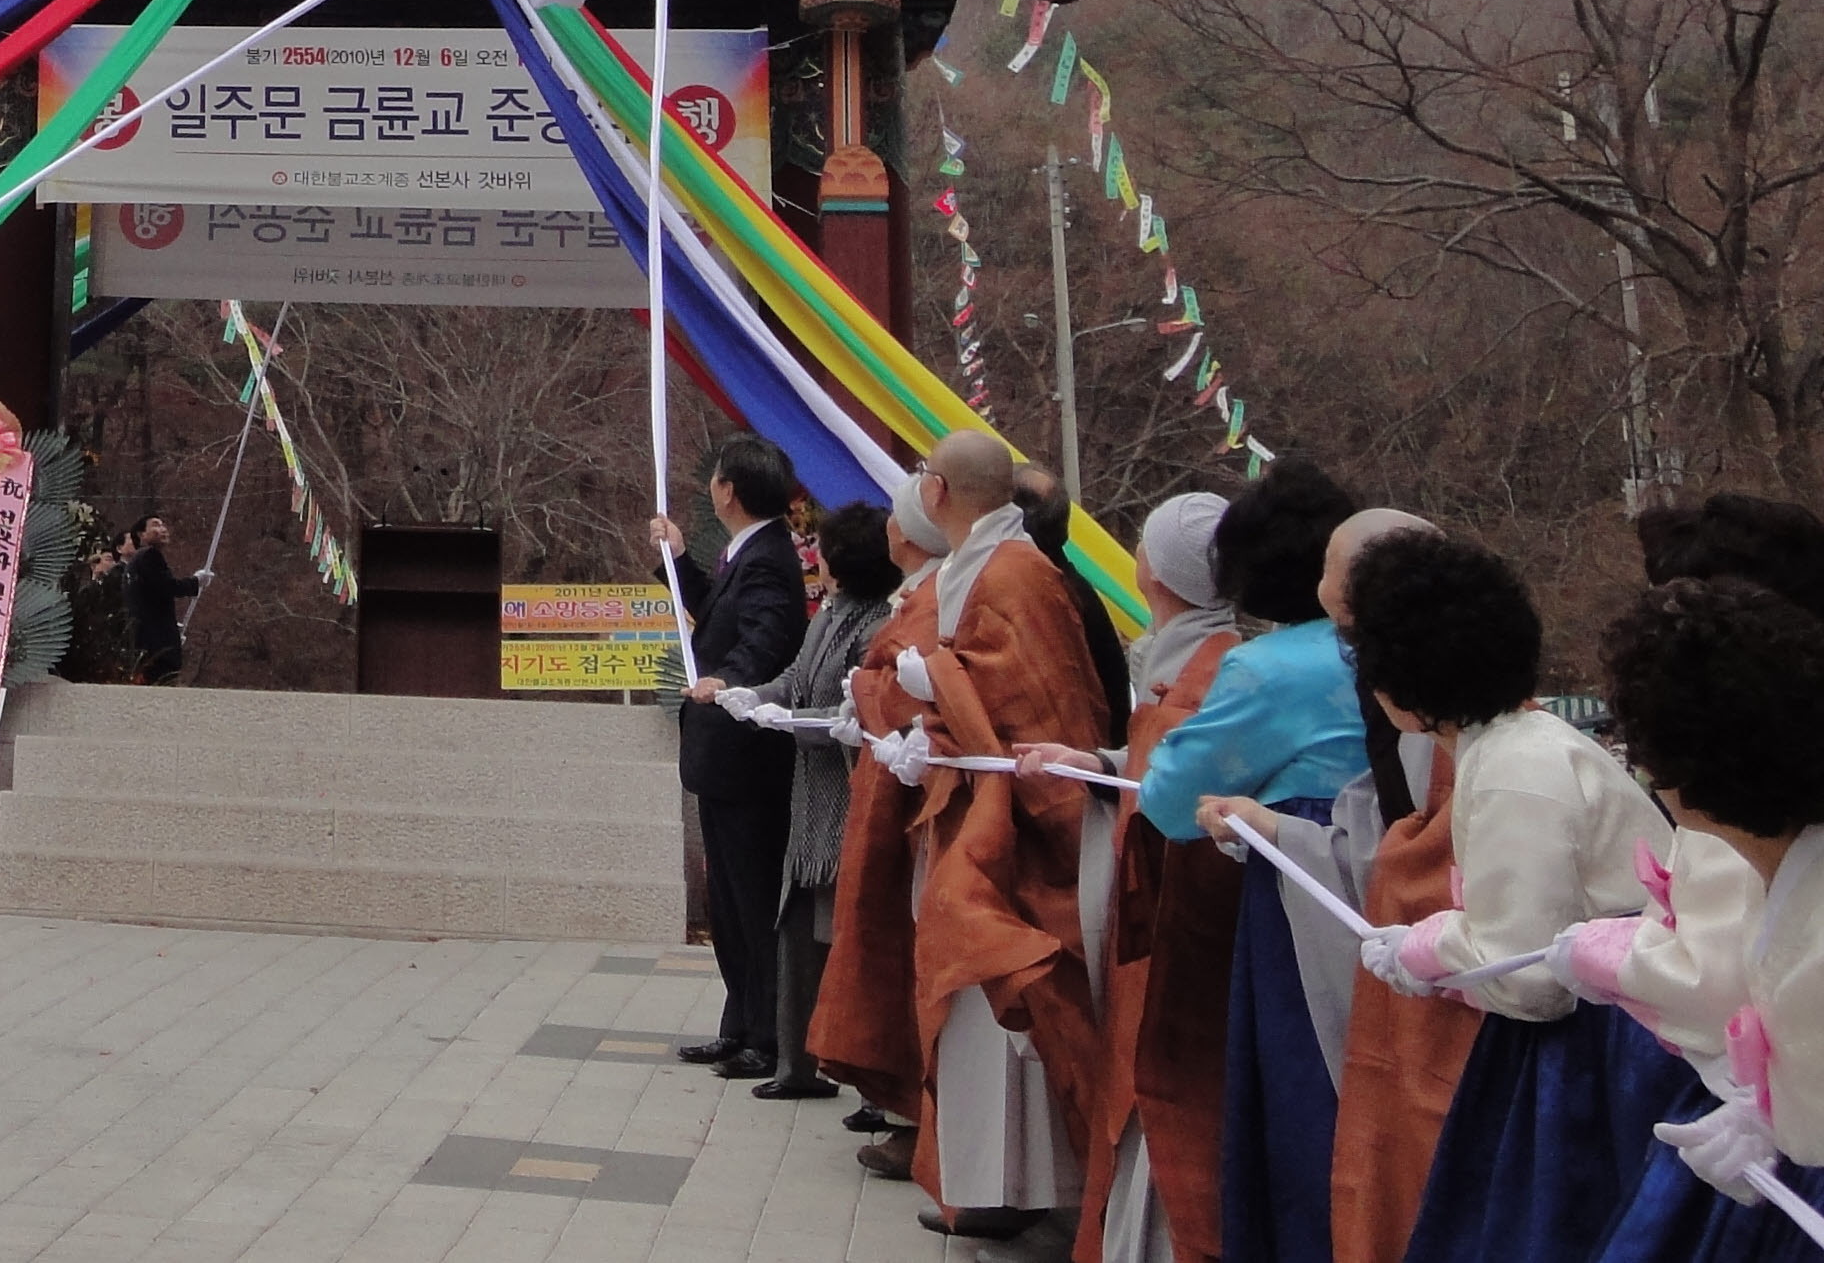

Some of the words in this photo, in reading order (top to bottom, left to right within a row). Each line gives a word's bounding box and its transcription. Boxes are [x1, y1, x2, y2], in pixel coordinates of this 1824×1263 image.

[246, 48, 277, 65] 불기
[282, 46, 386, 67] 2554(2010)년
[393, 47, 431, 67] 12월
[440, 47, 468, 67] 6일
[476, 48, 508, 66] 오전
[165, 83, 307, 140] 일주문
[323, 86, 470, 142] 금륜교
[677, 96, 721, 145] 행
[293, 170, 410, 188] 대한불교조계종
[416, 170, 471, 189] 선본사
[478, 170, 532, 190] 갓바위
[0, 476, 25, 501] 祝
[554, 586, 602, 598] 2011년
[532, 600, 624, 619] 소망등을
[577, 654, 627, 675] 접수
